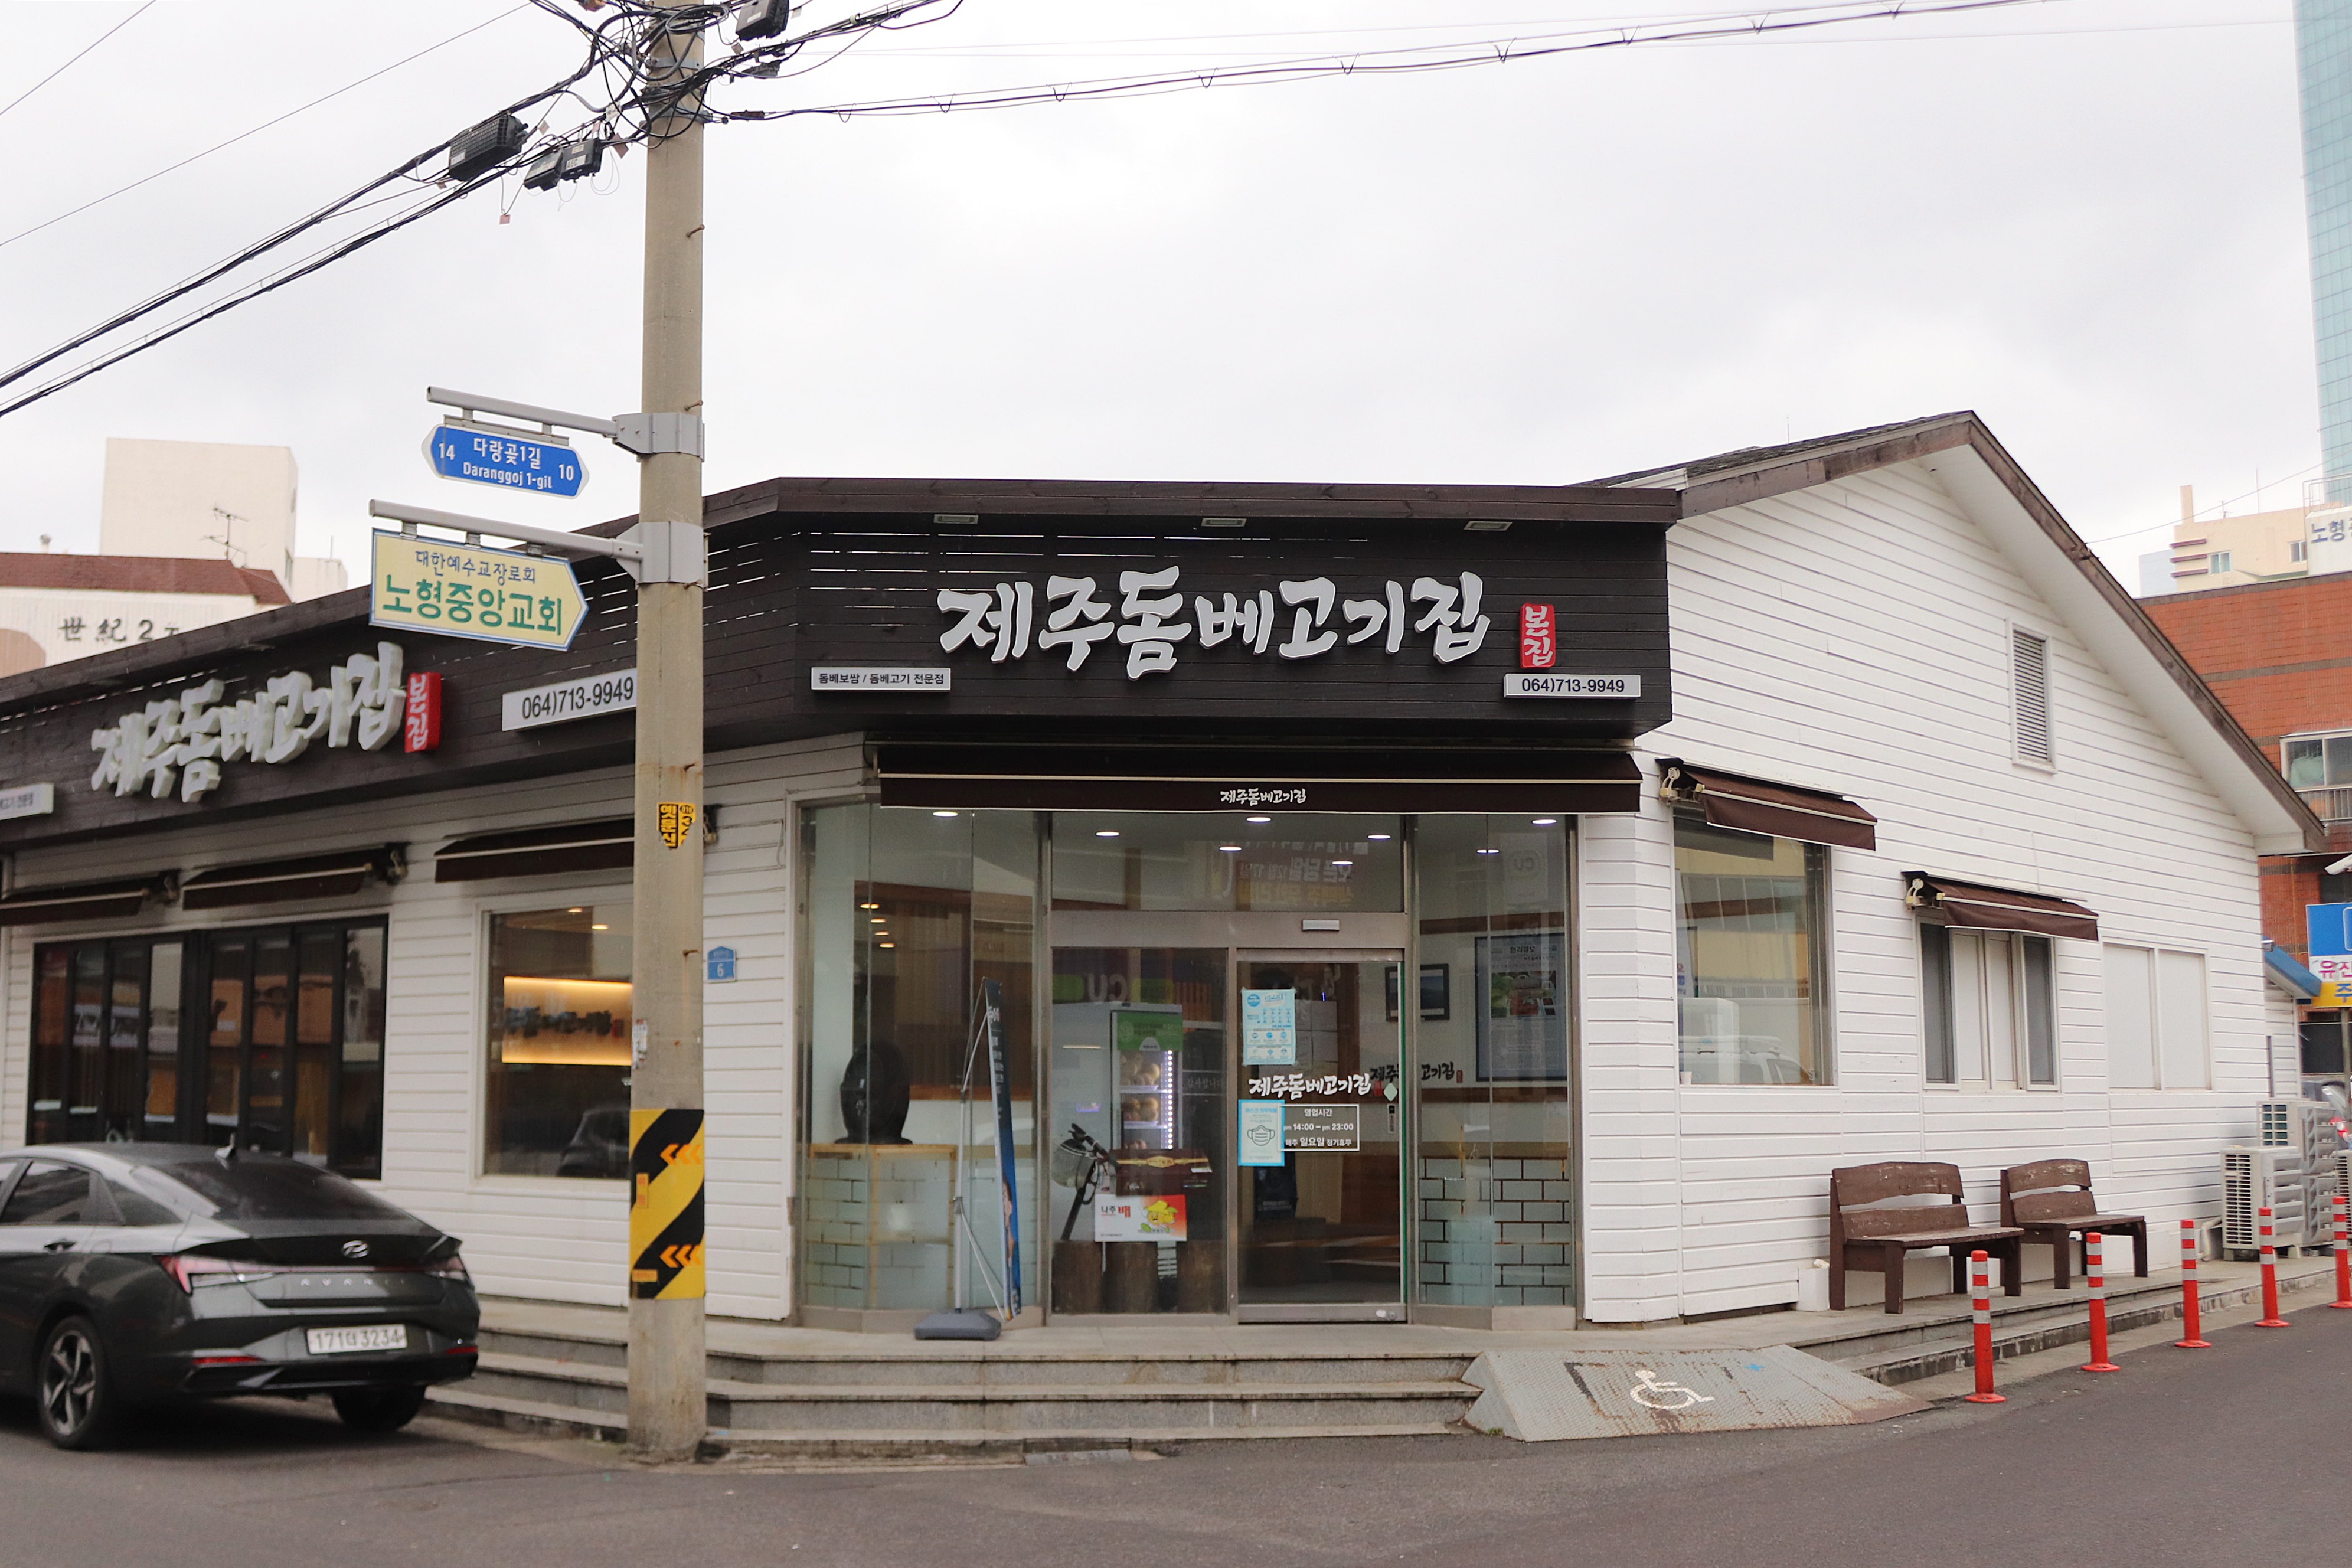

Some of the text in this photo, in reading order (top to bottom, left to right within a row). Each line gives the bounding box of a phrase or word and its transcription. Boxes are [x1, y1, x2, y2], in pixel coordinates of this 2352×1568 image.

[439, 442, 455, 461] 14
[473, 437, 541, 470] 다랑곶1길
[463, 461, 553, 490] Daranggoj 1-gil
[558, 464, 574, 481] 10
[2311, 517, 2352, 544] 노형
[416, 550, 536, 586] 대한예수교장로회
[383, 574, 561, 636] 노형중앙교회
[937, 565, 1491, 682] 제주돔베고기집
[1525, 605, 1554, 667] 본집
[818, 672, 859, 685] 돔베보쌈
[869, 672, 910, 685] 돔베고기
[913, 672, 945, 685] 전문점
[1521, 677, 1625, 694] 064)713-9949
[522, 676, 634, 720] 064)713-9949
[90, 640, 406, 803] 제주돔베고기집
[407, 674, 429, 750] 본집
[1220, 788, 1306, 806] 제주돔베고기집
[717, 963, 724, 978] 6
[1248, 1073, 1371, 1100] 제주돔베고기집
[1304, 1108, 1332, 1117] 영업시간
[1300, 1137, 1325, 1147] 일요일
